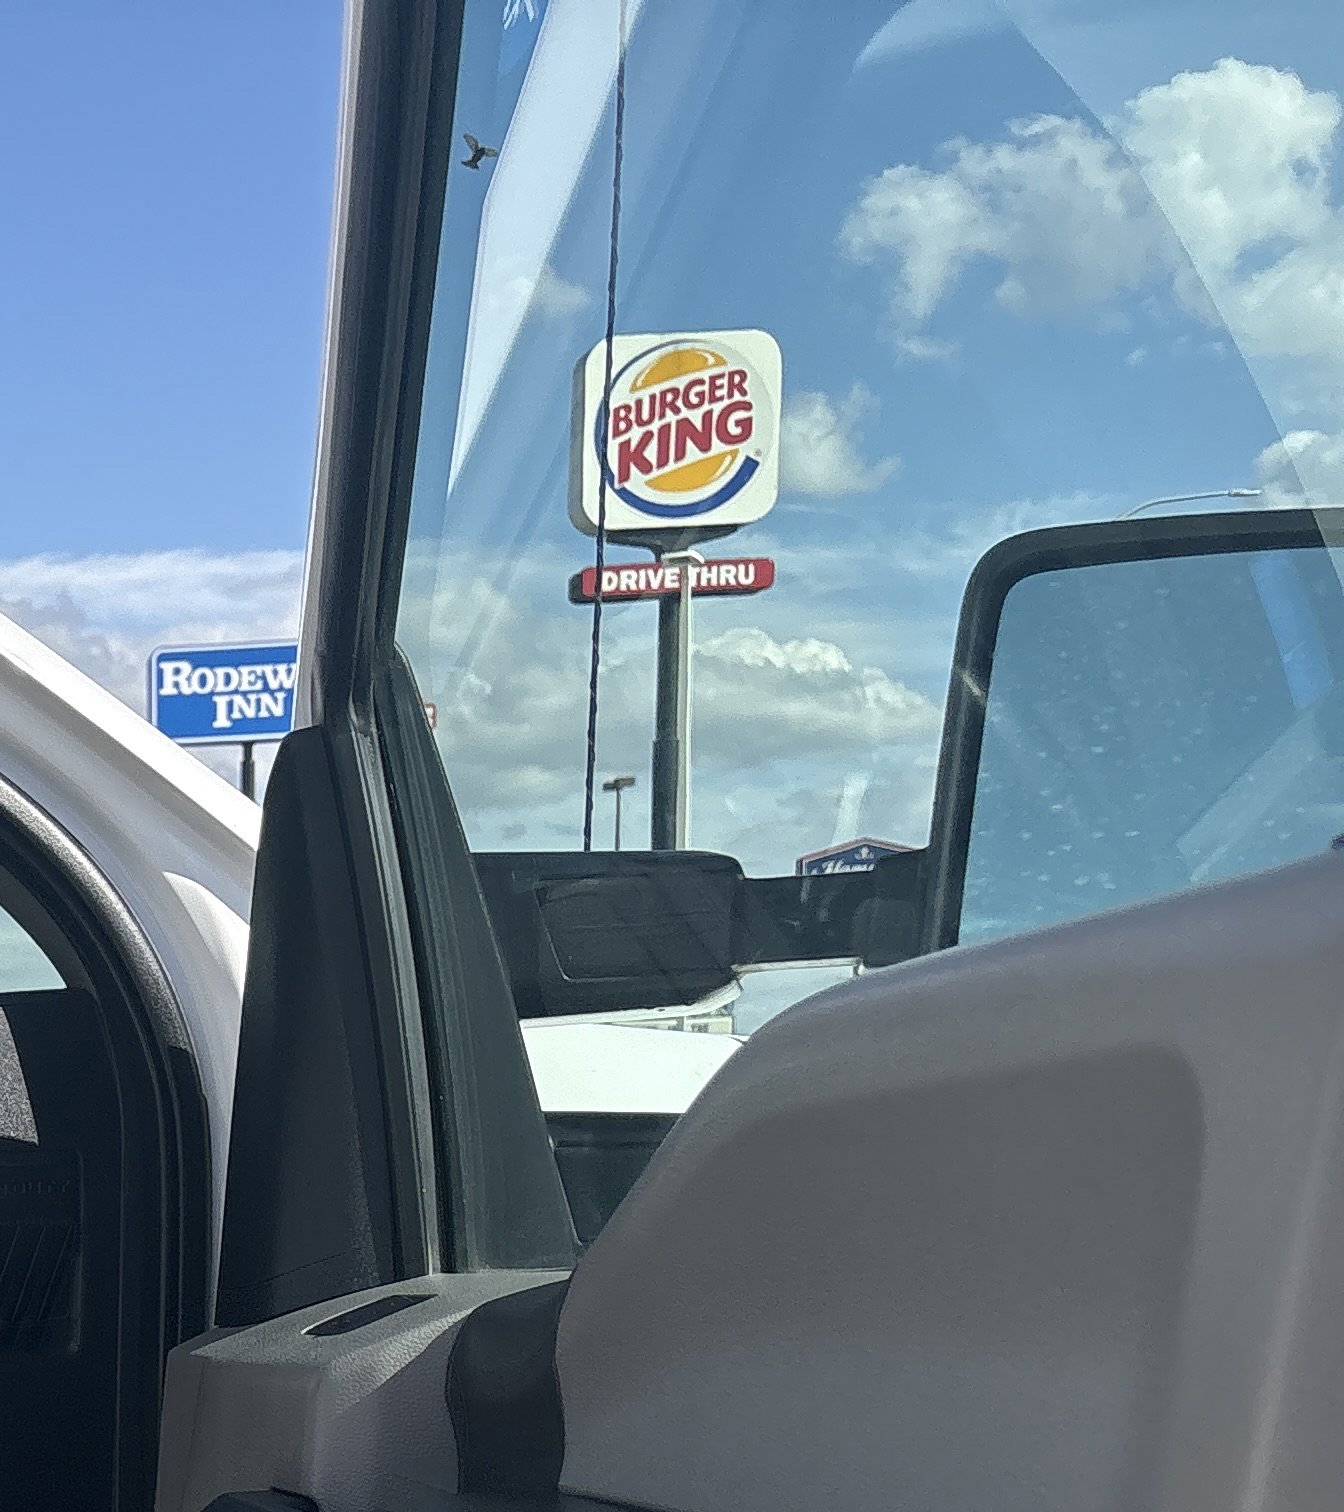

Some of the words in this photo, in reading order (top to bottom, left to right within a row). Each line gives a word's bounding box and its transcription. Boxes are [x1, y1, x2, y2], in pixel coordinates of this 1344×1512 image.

[612, 369, 749, 440] BURGER
[617, 400, 754, 485] KING
[601, 565, 680, 593] DRIVE
[688, 562, 755, 587] THRU
[211, 691, 288, 729] INN
